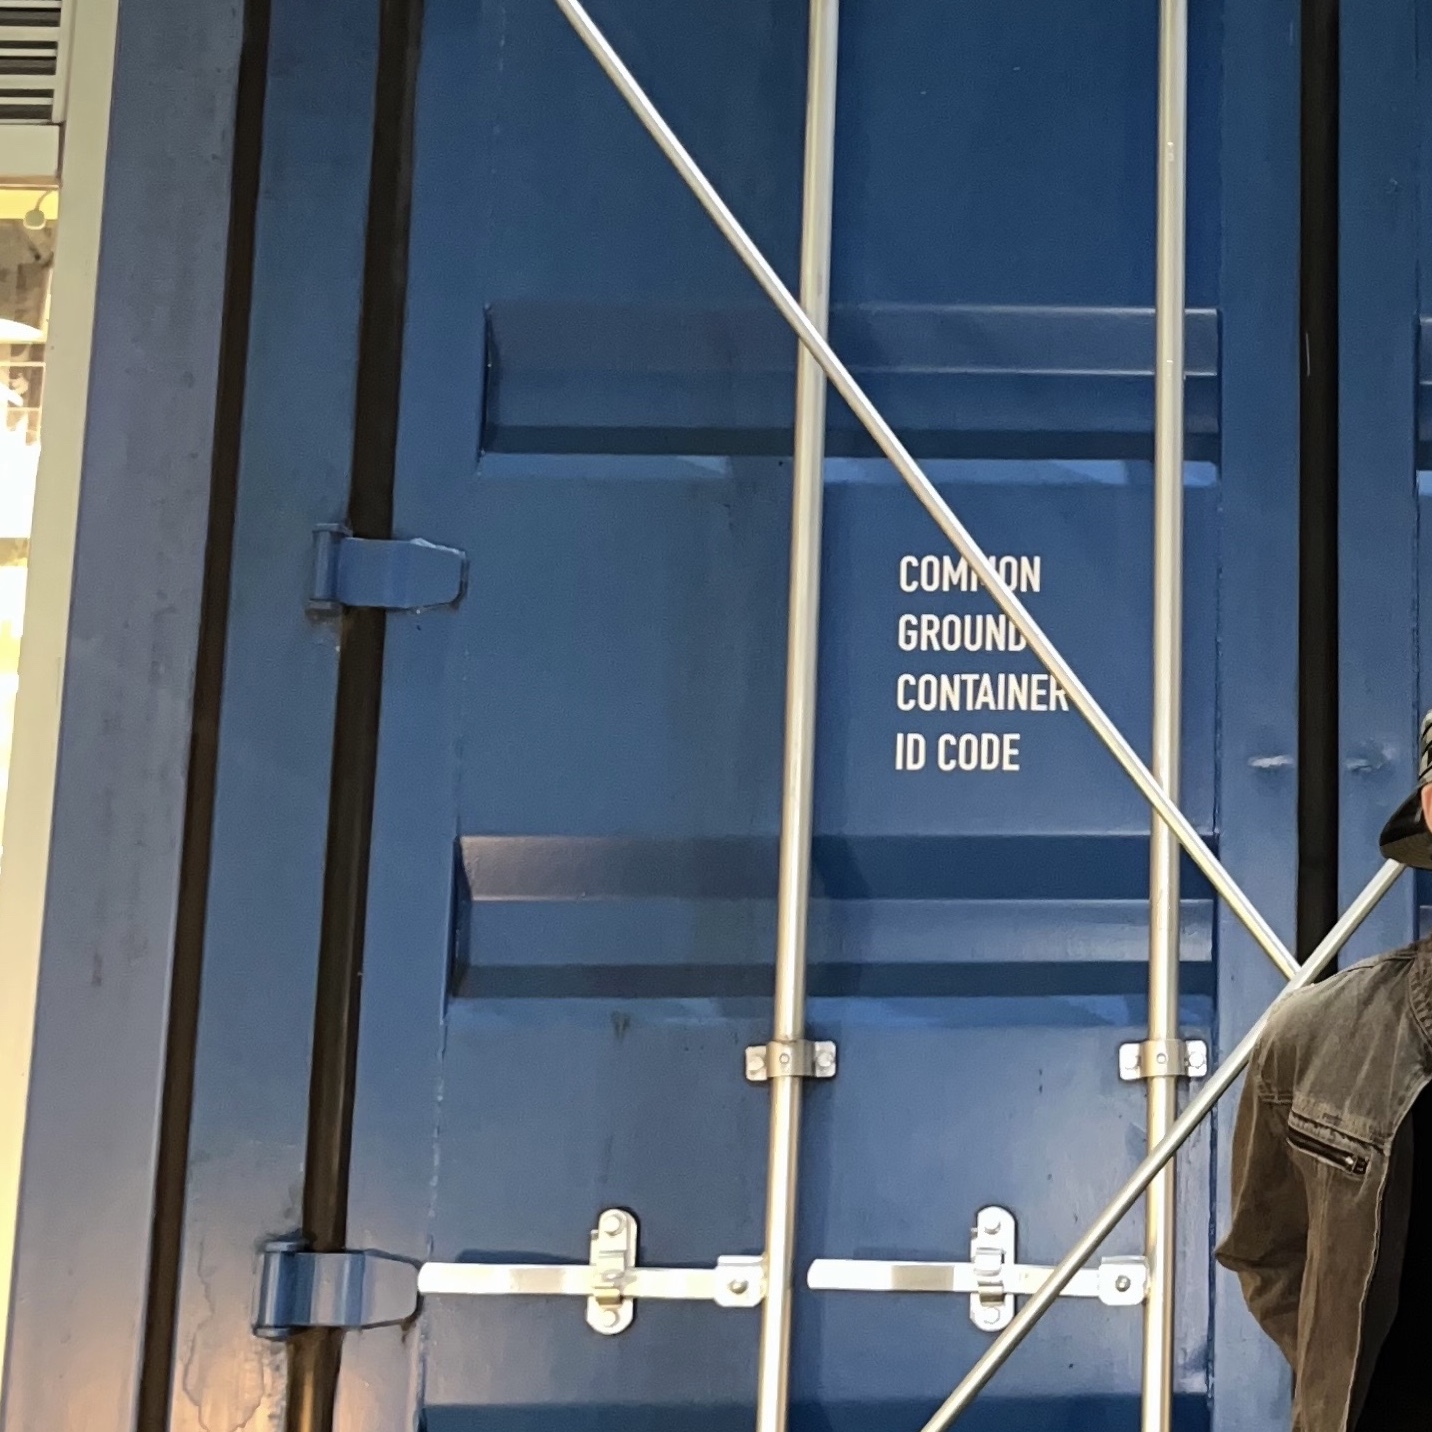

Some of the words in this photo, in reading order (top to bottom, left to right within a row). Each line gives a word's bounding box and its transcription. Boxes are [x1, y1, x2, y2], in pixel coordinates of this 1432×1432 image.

[898, 614, 1027, 652] GROUND
[897, 673, 1069, 711] CONTAINER
[895, 732, 926, 771] ID
[938, 732, 1021, 771] CODE
